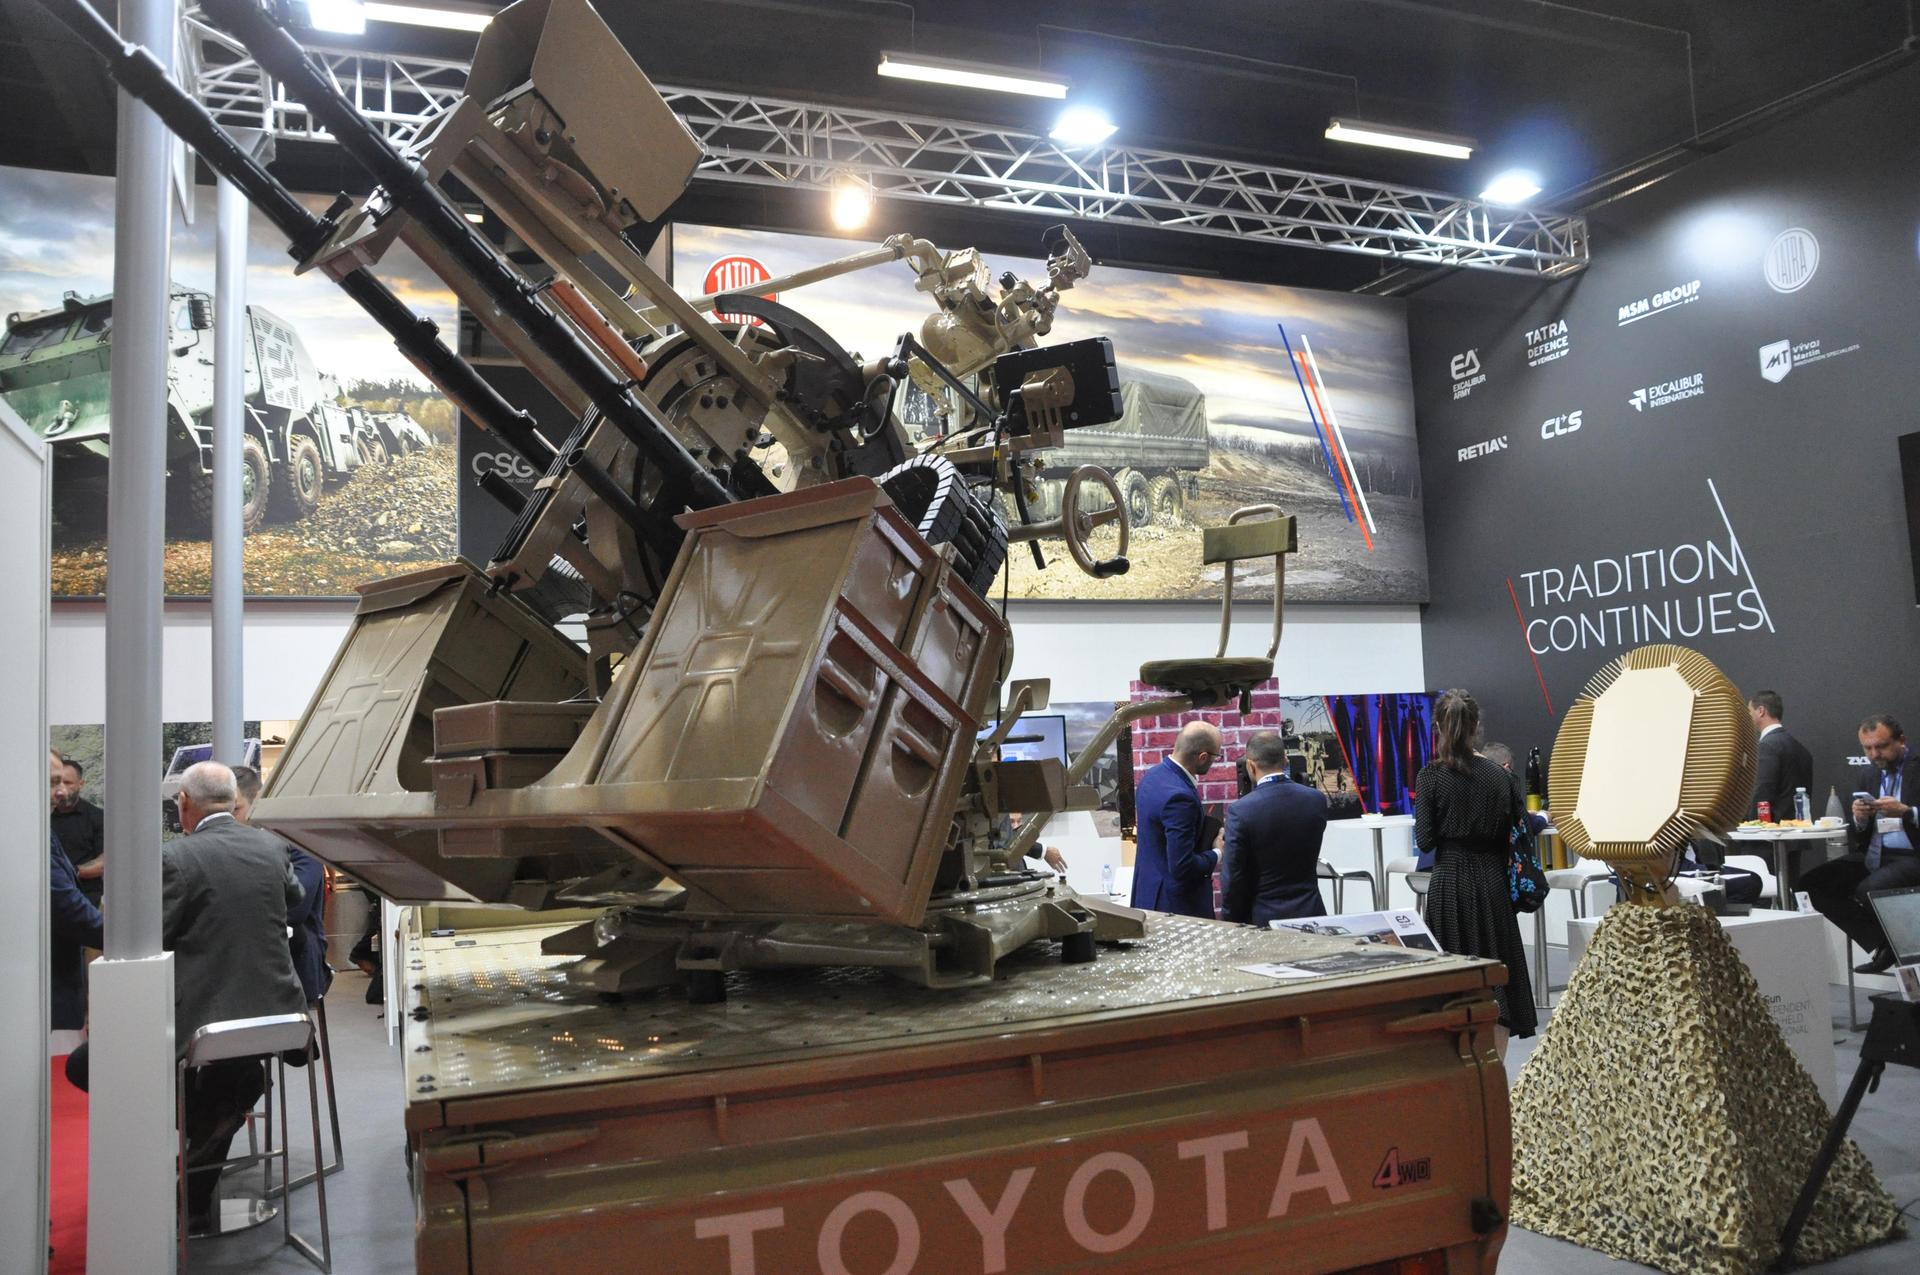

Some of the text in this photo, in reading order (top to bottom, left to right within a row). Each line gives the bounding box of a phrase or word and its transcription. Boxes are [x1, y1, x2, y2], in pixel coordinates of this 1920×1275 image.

[1618, 279, 1701, 321] MSM GROUP
[1525, 319, 1568, 346] TATRA
[1527, 335, 1569, 359] DEFENCE
[1536, 352, 1560, 366] VEHICLE
[1793, 349, 1821, 361] Martin
[1453, 374, 1486, 392] EXCALIBUR
[1453, 387, 1471, 400] ARMY
[1648, 373, 1704, 399] EXCALIBUR
[1650, 386, 1705, 408] INTERNATIONAL
[1541, 410, 1582, 440] CLS
[471, 451, 535, 478] CSG
[1520, 539, 1739, 607] TRADITION
[1526, 589, 1766, 655] CONTINUES
[1372, 1146, 1431, 1189] 4WD
[694, 1116, 1351, 1275] TOYOTA
